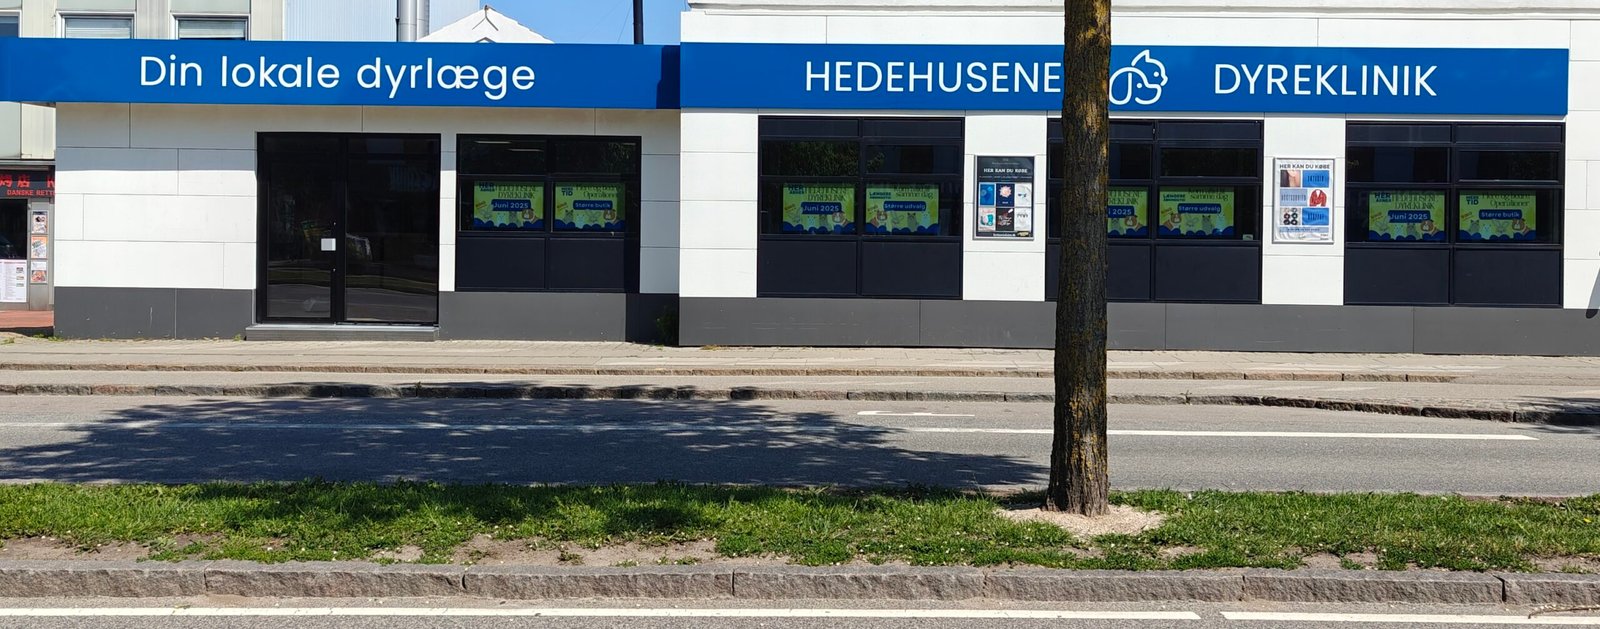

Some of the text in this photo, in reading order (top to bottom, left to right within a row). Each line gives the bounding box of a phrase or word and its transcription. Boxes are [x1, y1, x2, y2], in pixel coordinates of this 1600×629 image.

[140, 54, 536, 101] Din lokale dyrlæge
[805, 61, 1062, 93] HEDEHUSENE
[1214, 63, 1438, 96] DYREKLINIK
[1199, 205, 1221, 213] udvalg
